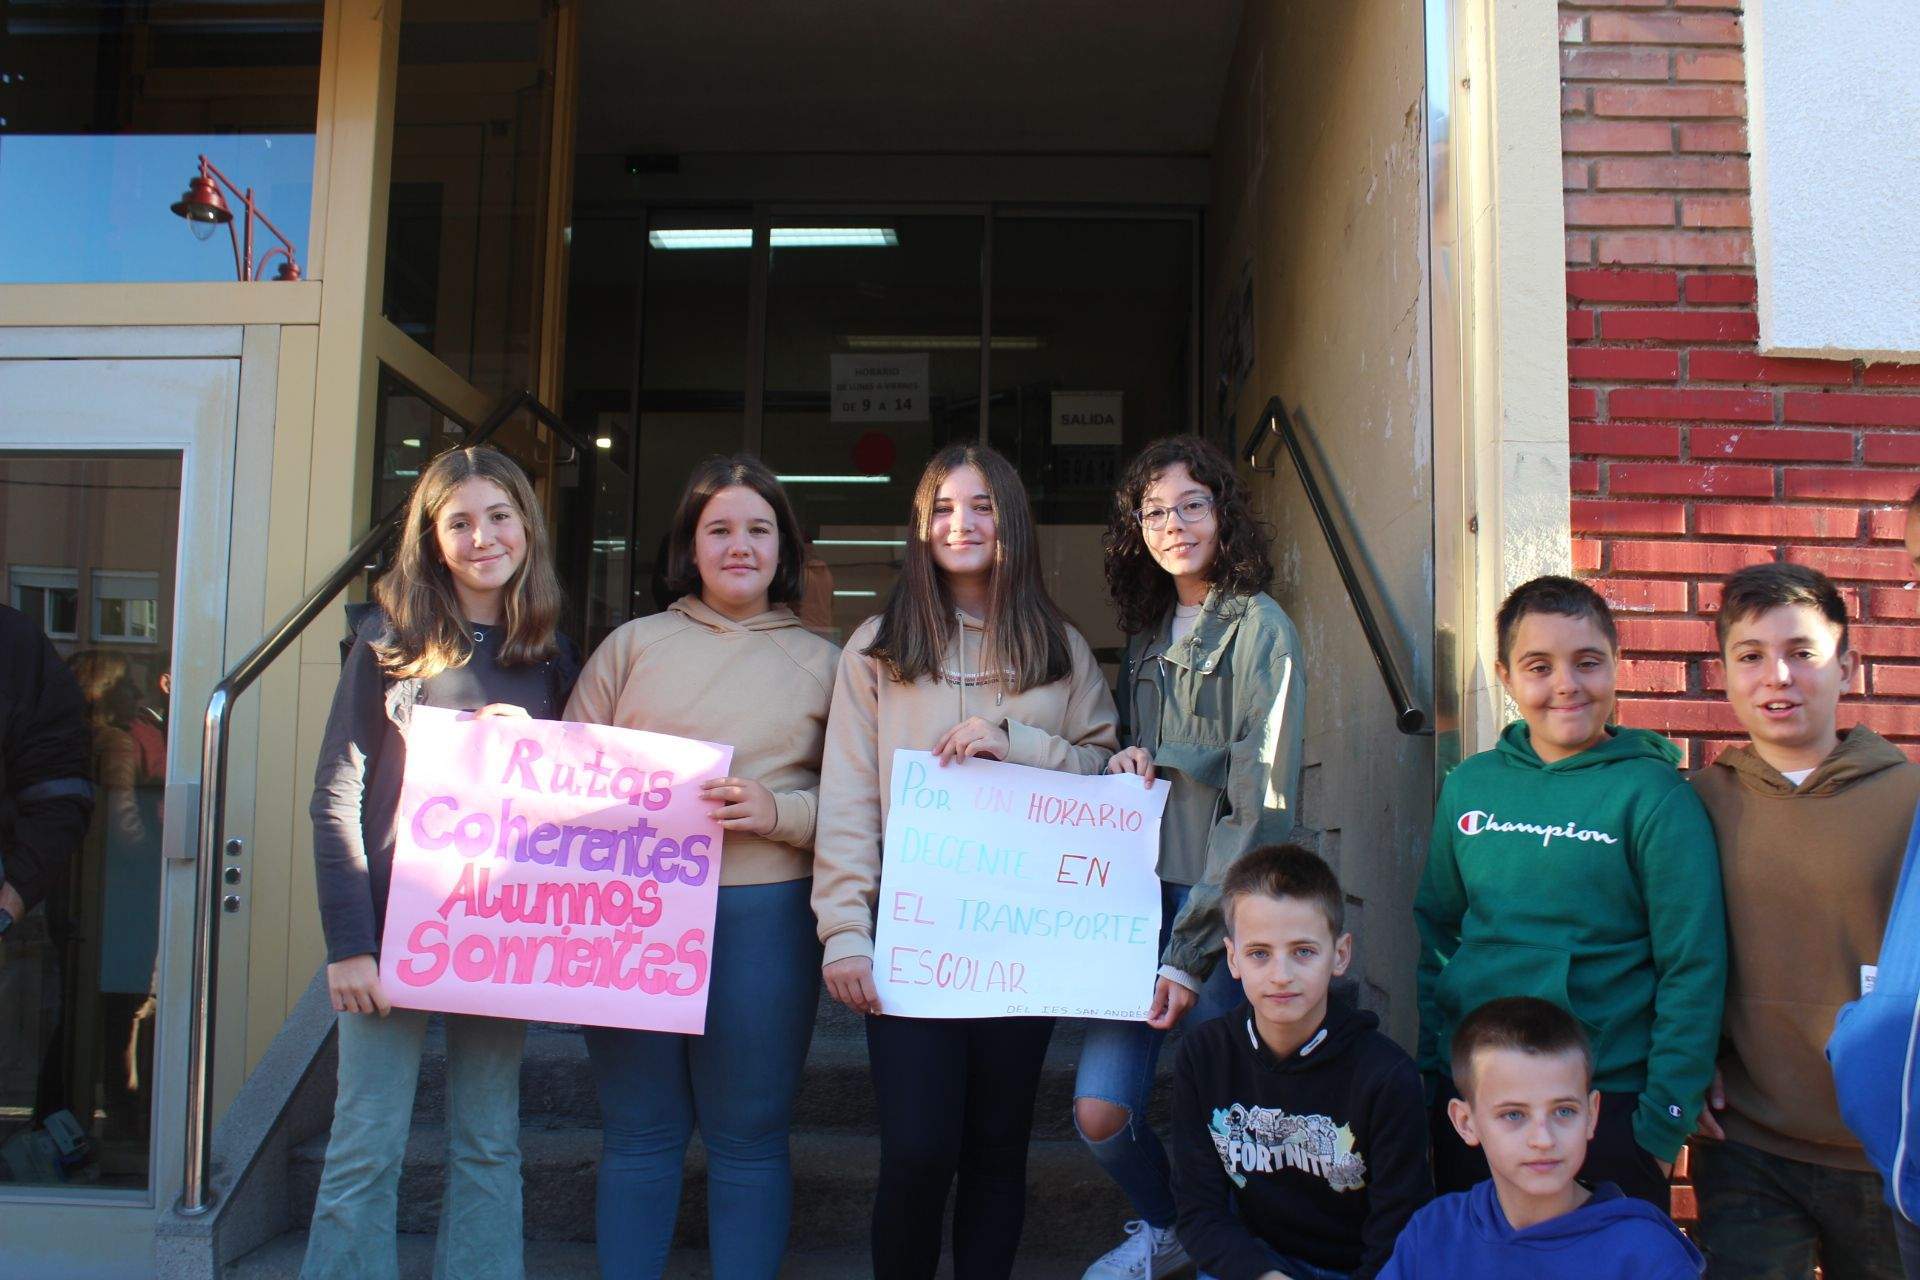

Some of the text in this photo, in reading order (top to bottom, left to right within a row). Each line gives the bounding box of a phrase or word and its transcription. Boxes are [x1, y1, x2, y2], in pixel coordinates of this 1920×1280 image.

[842, 397, 912, 412] DE 9 A 14
[1061, 413, 1114, 425] SALIDA
[500, 738, 674, 811] Rutas
[974, 786, 1015, 814] UN
[1027, 792, 1143, 832] HORARIO
[1457, 810, 1618, 847] Champion
[411, 796, 711, 886] Coherentes
[900, 827, 1111, 888] DECENTE EN
[437, 862, 663, 928] Alumnos
[893, 891, 1149, 945] EL TRANSPORTE
[396, 920, 708, 996] Sonrientes
[889, 946, 1028, 994] ESCOLAR
[1006, 1005, 1031, 1014] DEL
[1041, 1005, 1069, 1014] IES
[1075, 1007, 1099, 1016] SAN
[1228, 1140, 1333, 1180] FORTNITE
